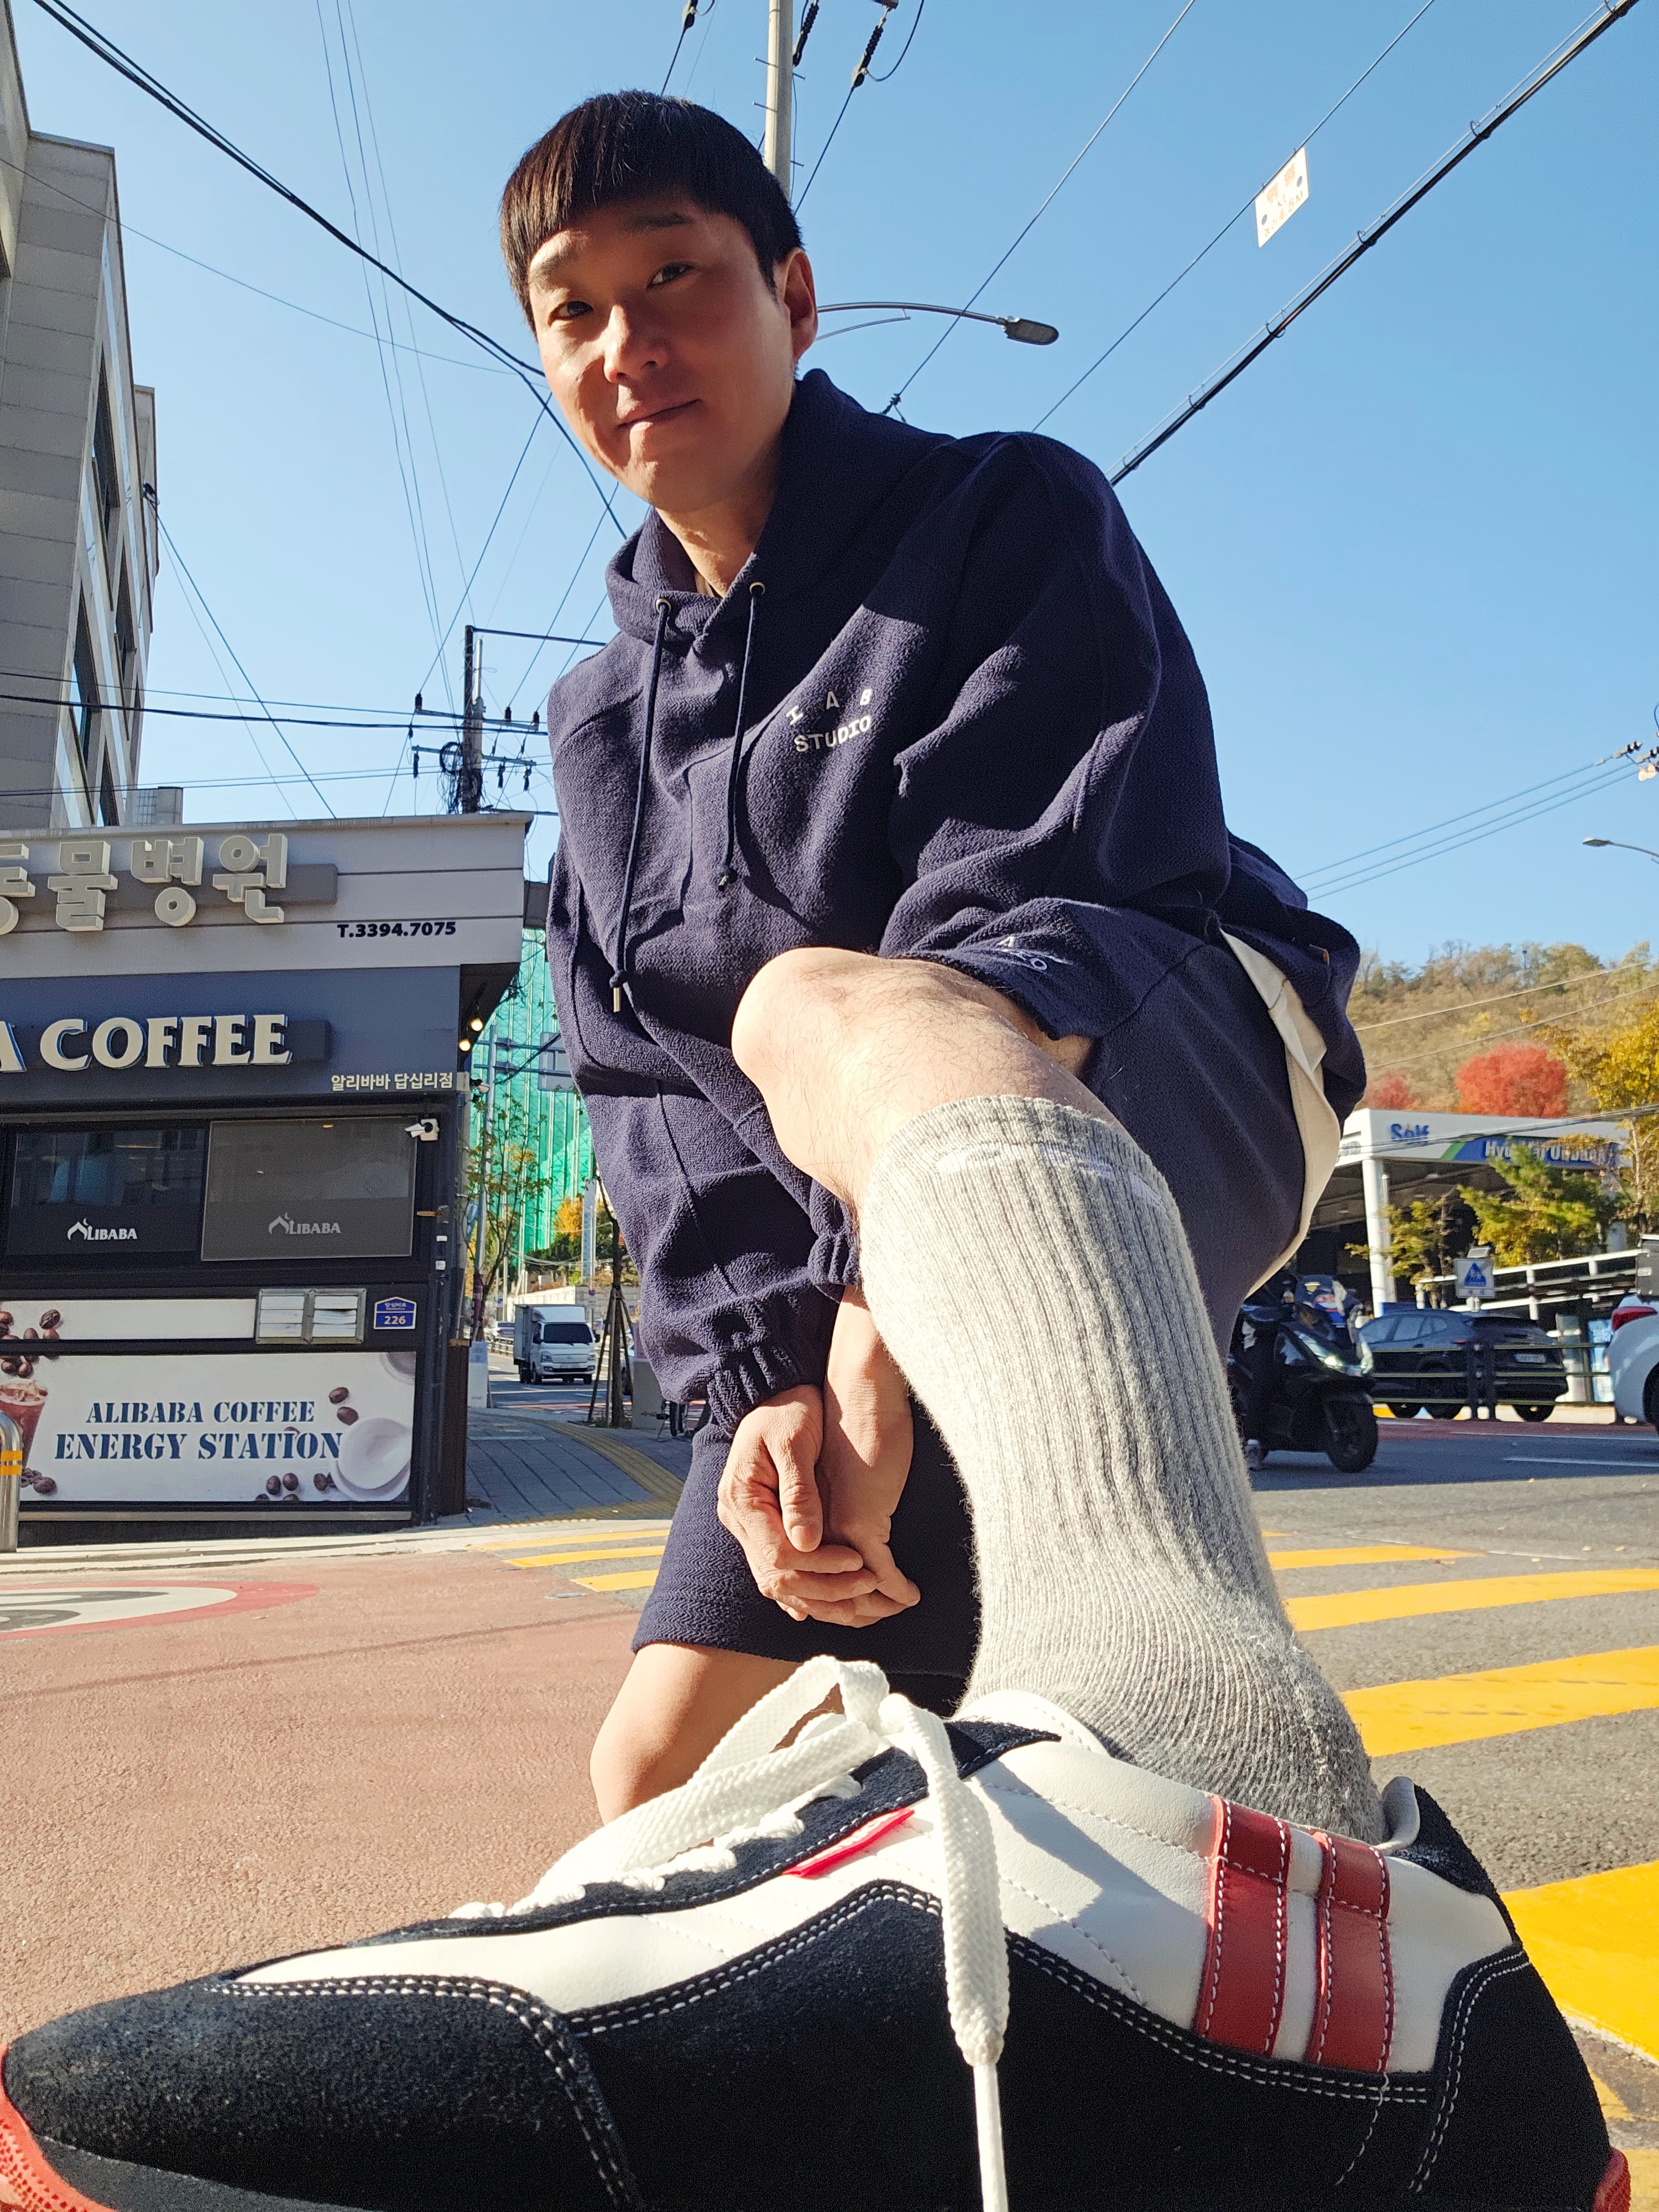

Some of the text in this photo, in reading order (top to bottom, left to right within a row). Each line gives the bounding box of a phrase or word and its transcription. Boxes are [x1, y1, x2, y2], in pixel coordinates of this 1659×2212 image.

[794, 716, 872, 752] STUDIO
[337, 922, 456, 938] T.3394.7075
[40, 1014, 292, 1071] COFFEE
[332, 1072, 452, 1091] 알리바바 답십리점
[384, 1316, 406, 1324] 226
[86, 1401, 315, 1423] ALIBABA COFFEE
[55, 1432, 343, 1460] ENERGY STATION
